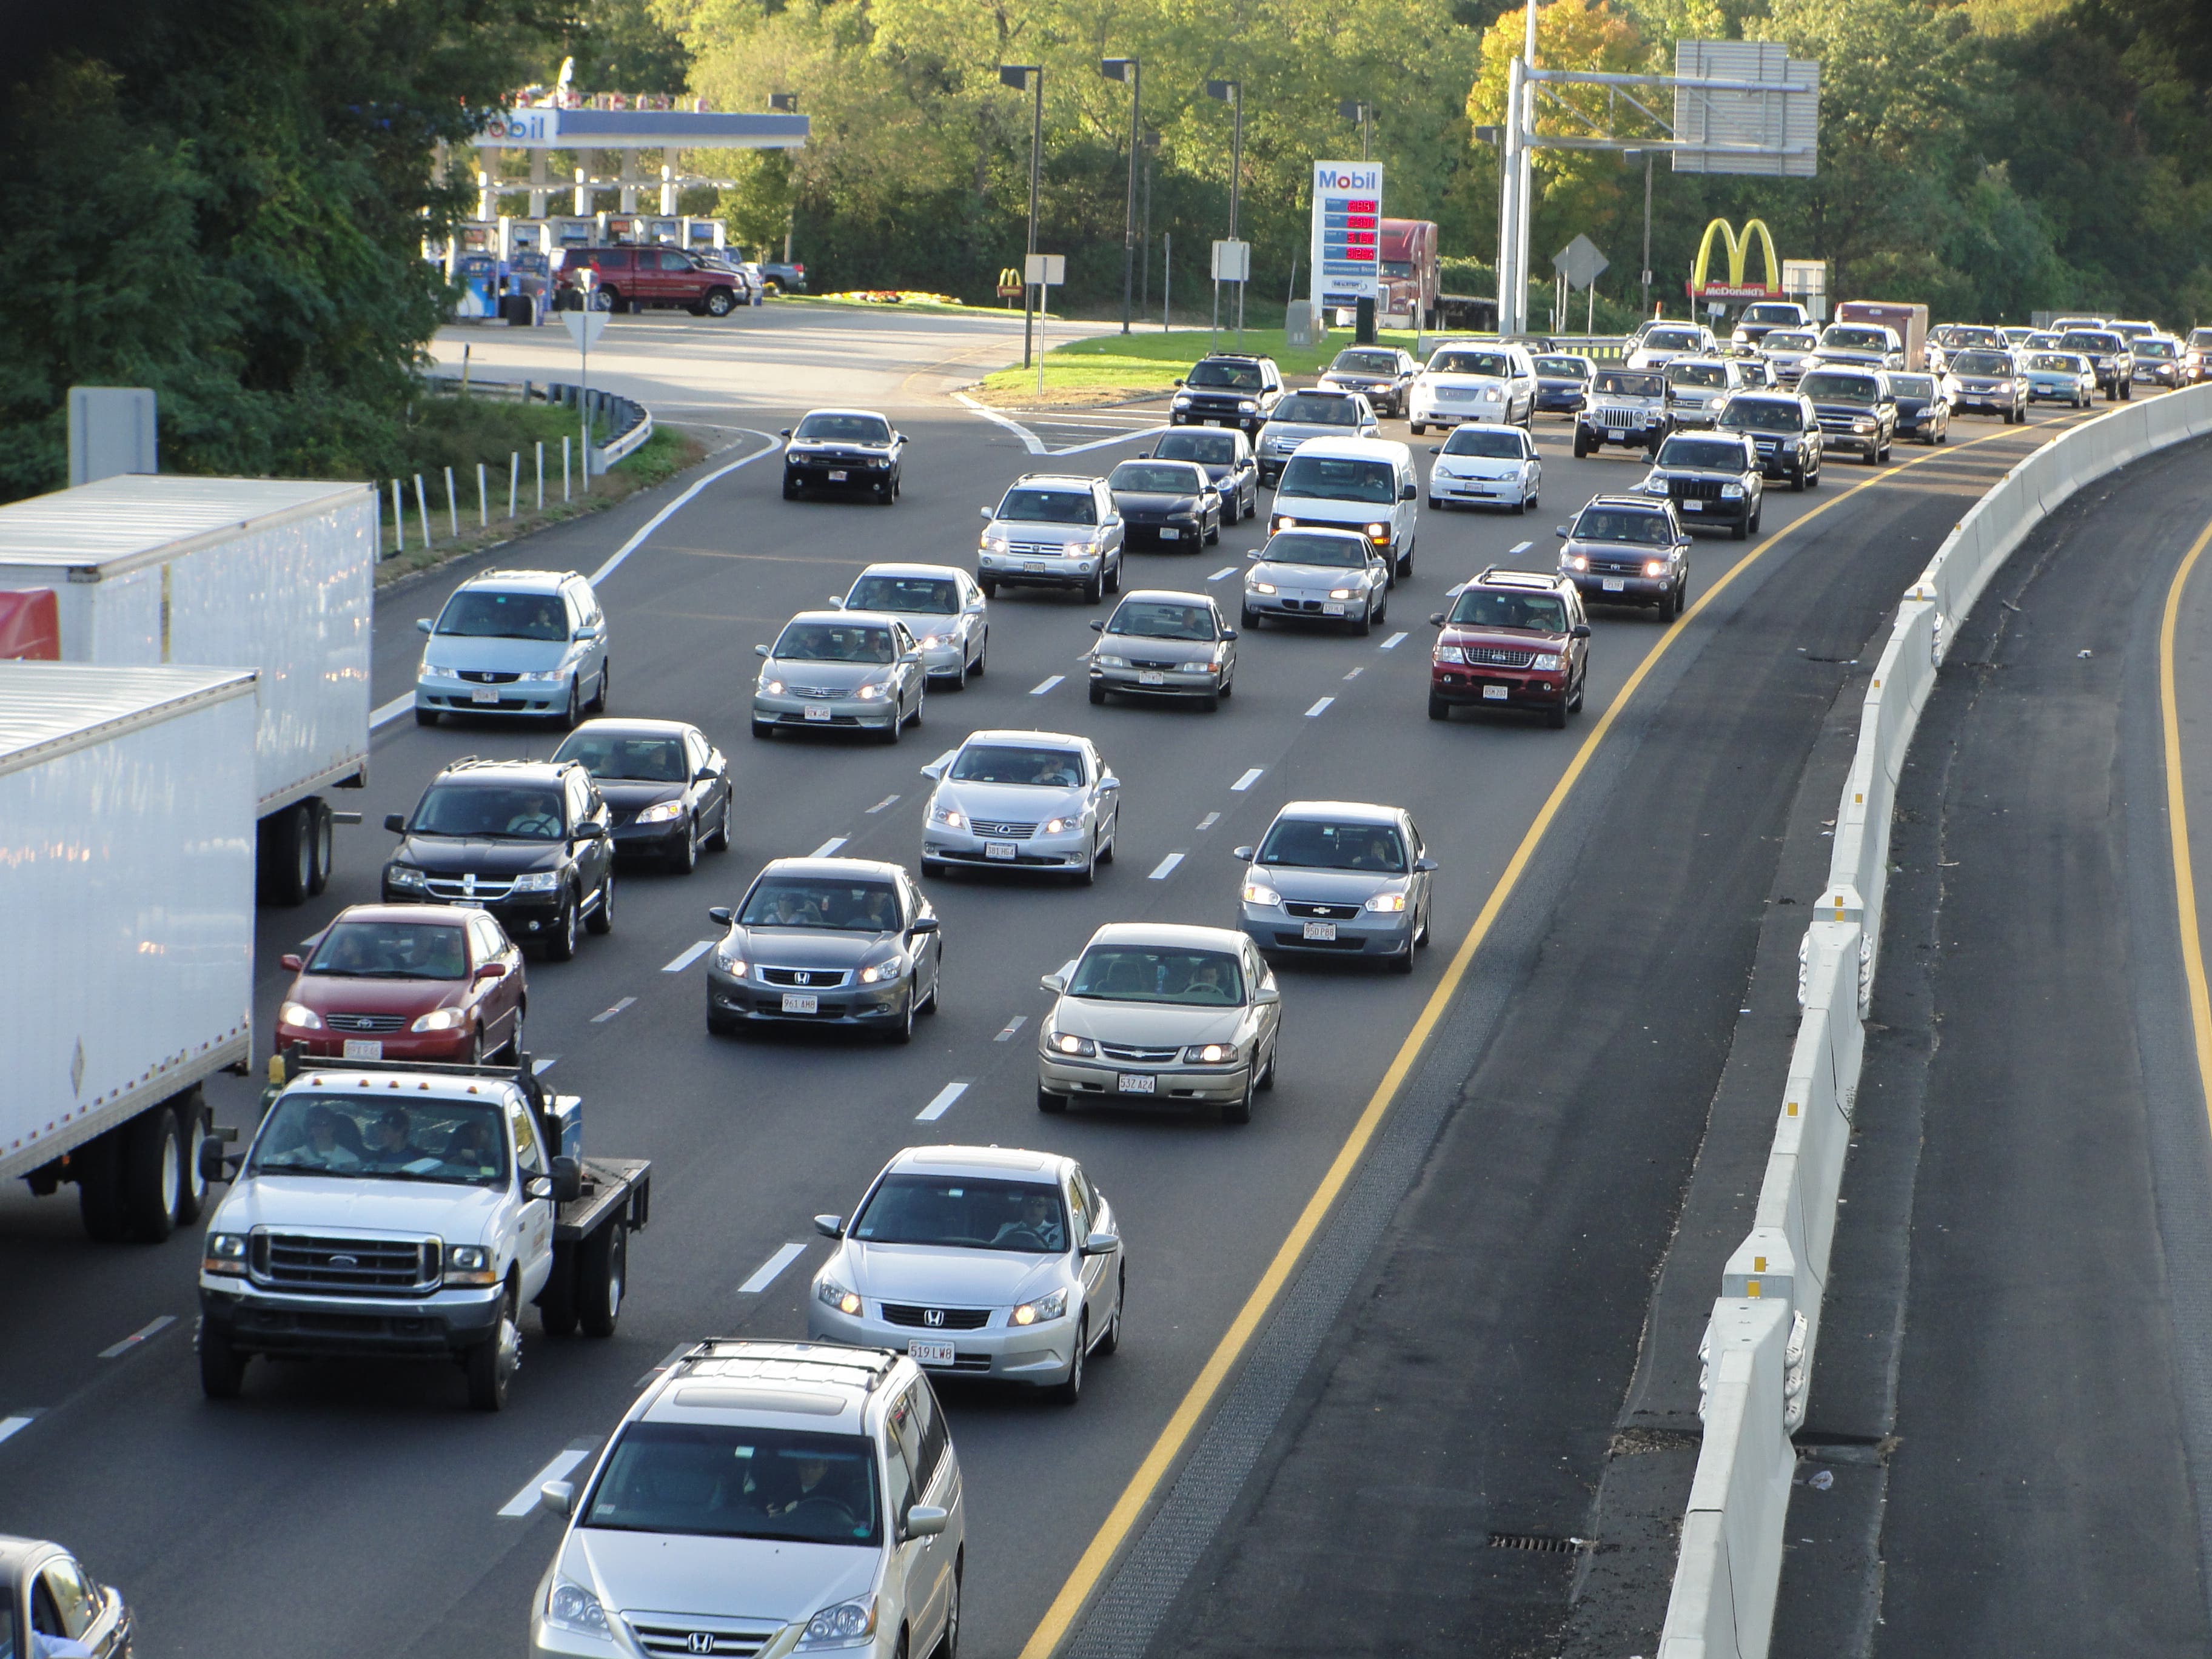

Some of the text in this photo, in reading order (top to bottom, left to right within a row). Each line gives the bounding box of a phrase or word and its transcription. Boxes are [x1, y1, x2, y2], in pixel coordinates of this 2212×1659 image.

[489, 116, 545, 138] obil
[1319, 170, 1375, 189] Mobil
[1706, 287, 1765, 297] McDonald's
[1321, 928, 1334, 936] P88
[784, 999, 816, 1009] 961 AH8
[1138, 1080, 1153, 1090] A24
[911, 1346, 952, 1359] 519 LW8
